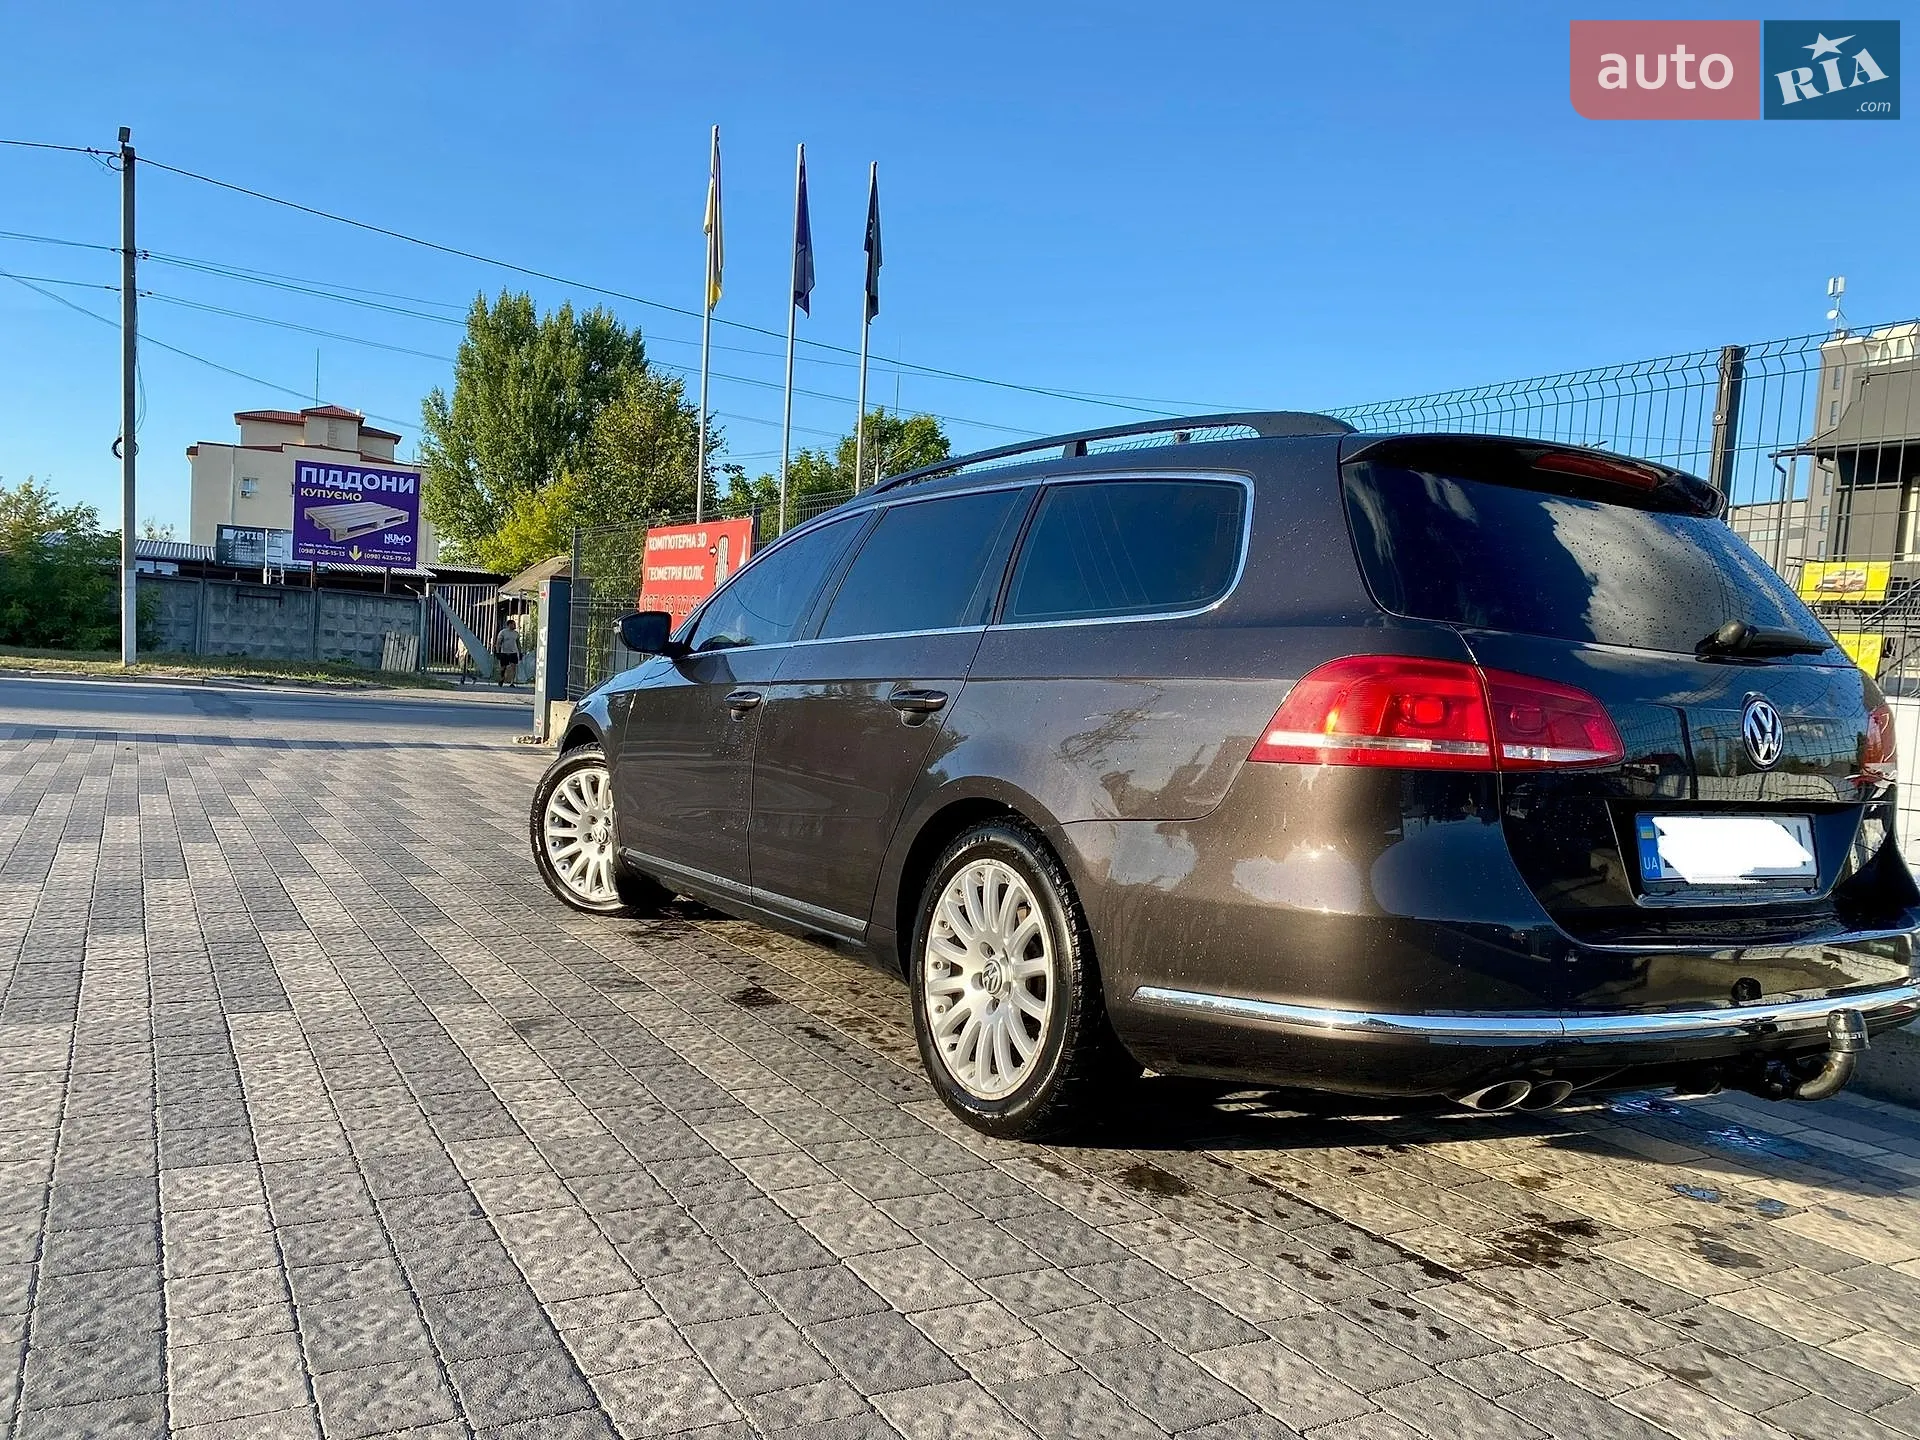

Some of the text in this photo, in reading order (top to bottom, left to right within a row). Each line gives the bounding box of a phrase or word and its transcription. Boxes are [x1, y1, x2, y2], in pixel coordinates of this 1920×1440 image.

[300, 466, 415, 494] ПІДДОНИ
[300, 487, 362, 502] КУПУЄМО
[1643, 856, 1659, 870] UA
